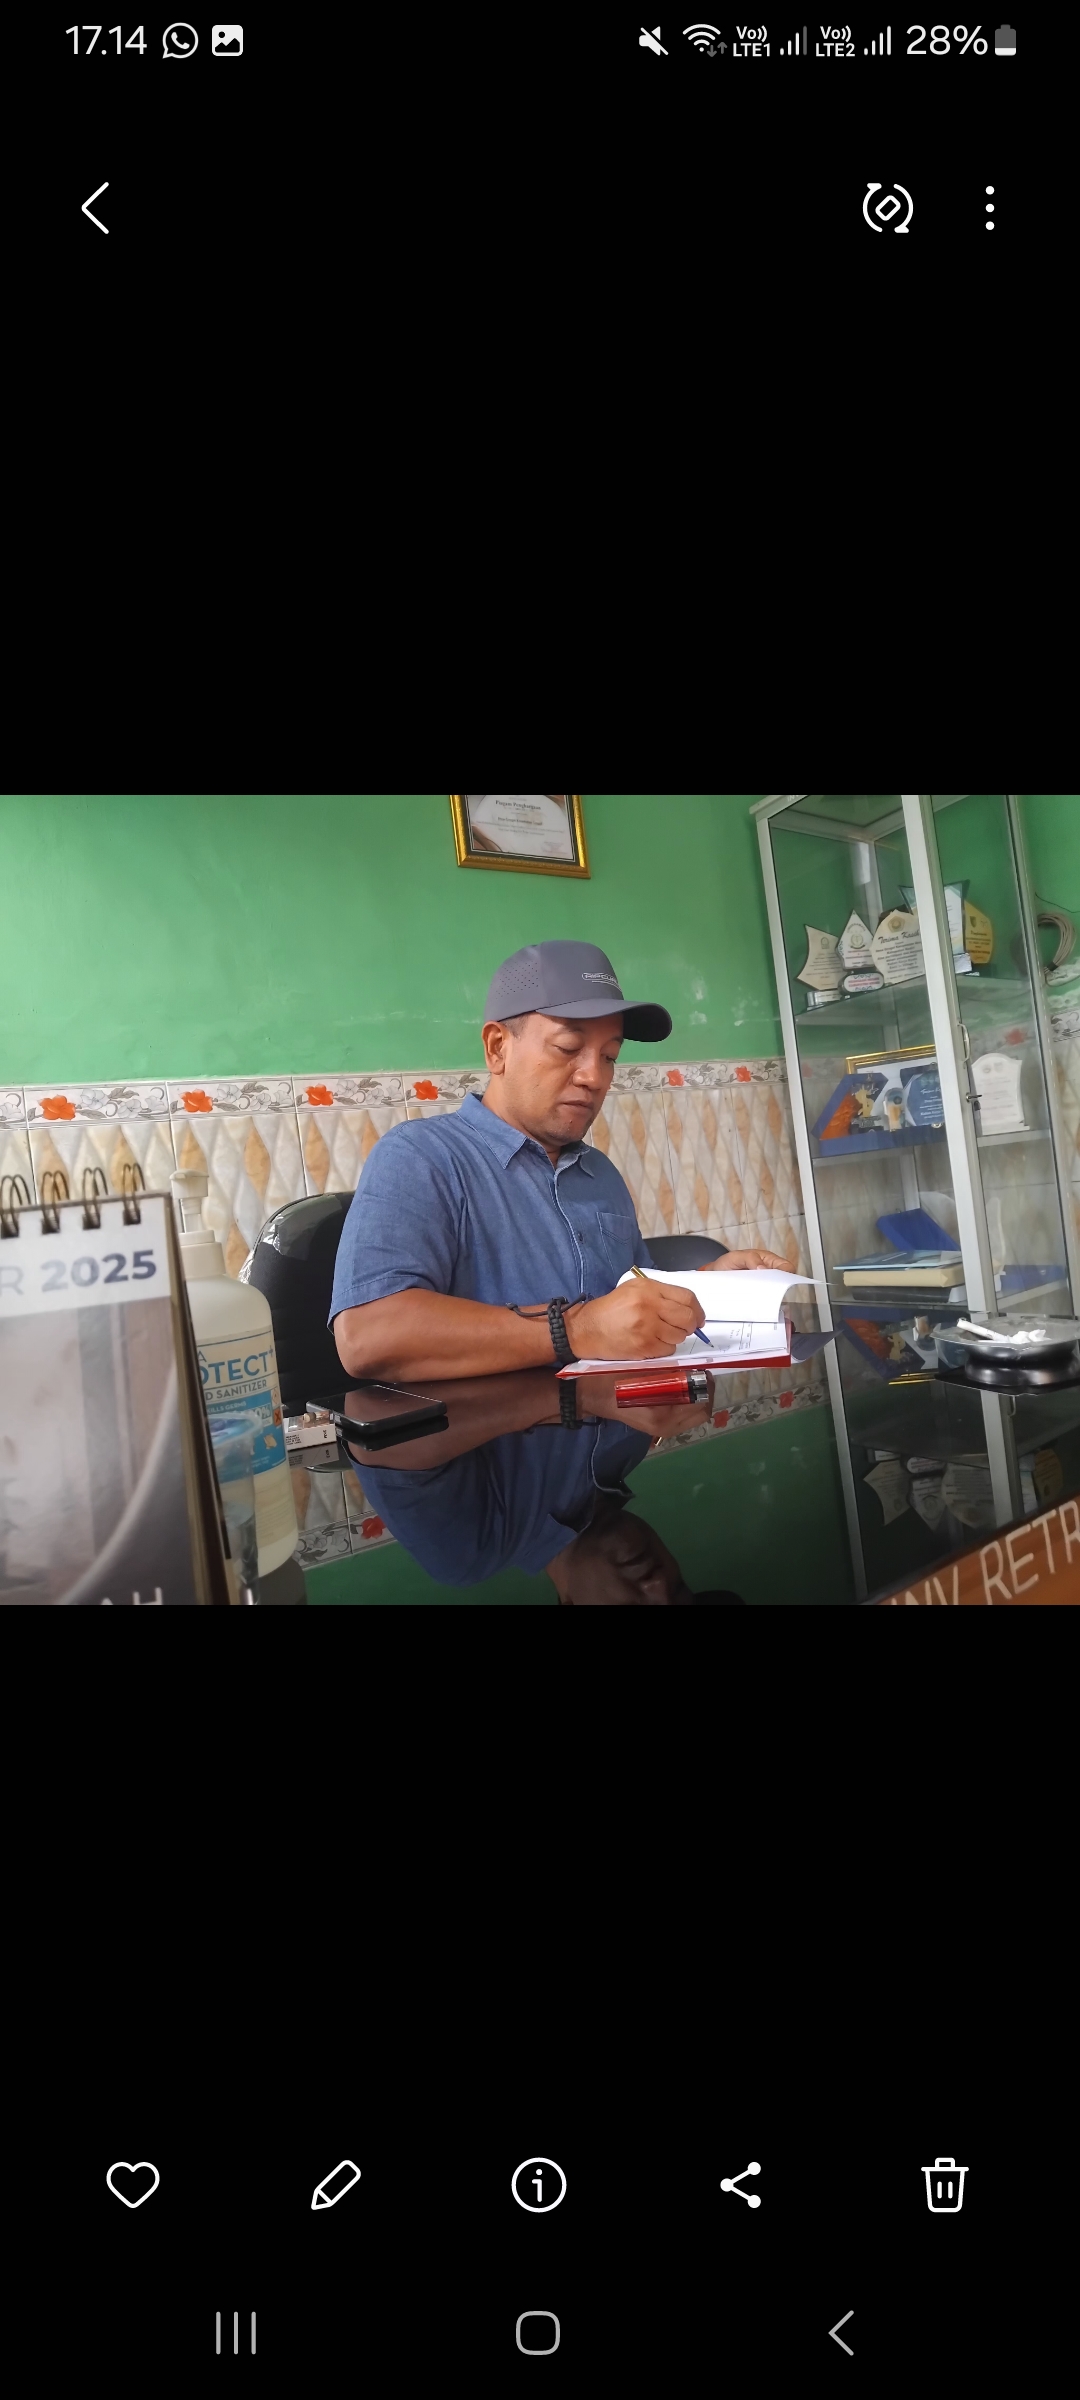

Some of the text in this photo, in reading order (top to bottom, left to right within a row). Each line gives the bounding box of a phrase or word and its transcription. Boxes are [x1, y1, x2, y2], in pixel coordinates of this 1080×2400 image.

[40, 1249, 157, 1293] 2025
[216, 1379, 267, 1399] SANITIZER
[225, 1401, 247, 1410] GERMS
